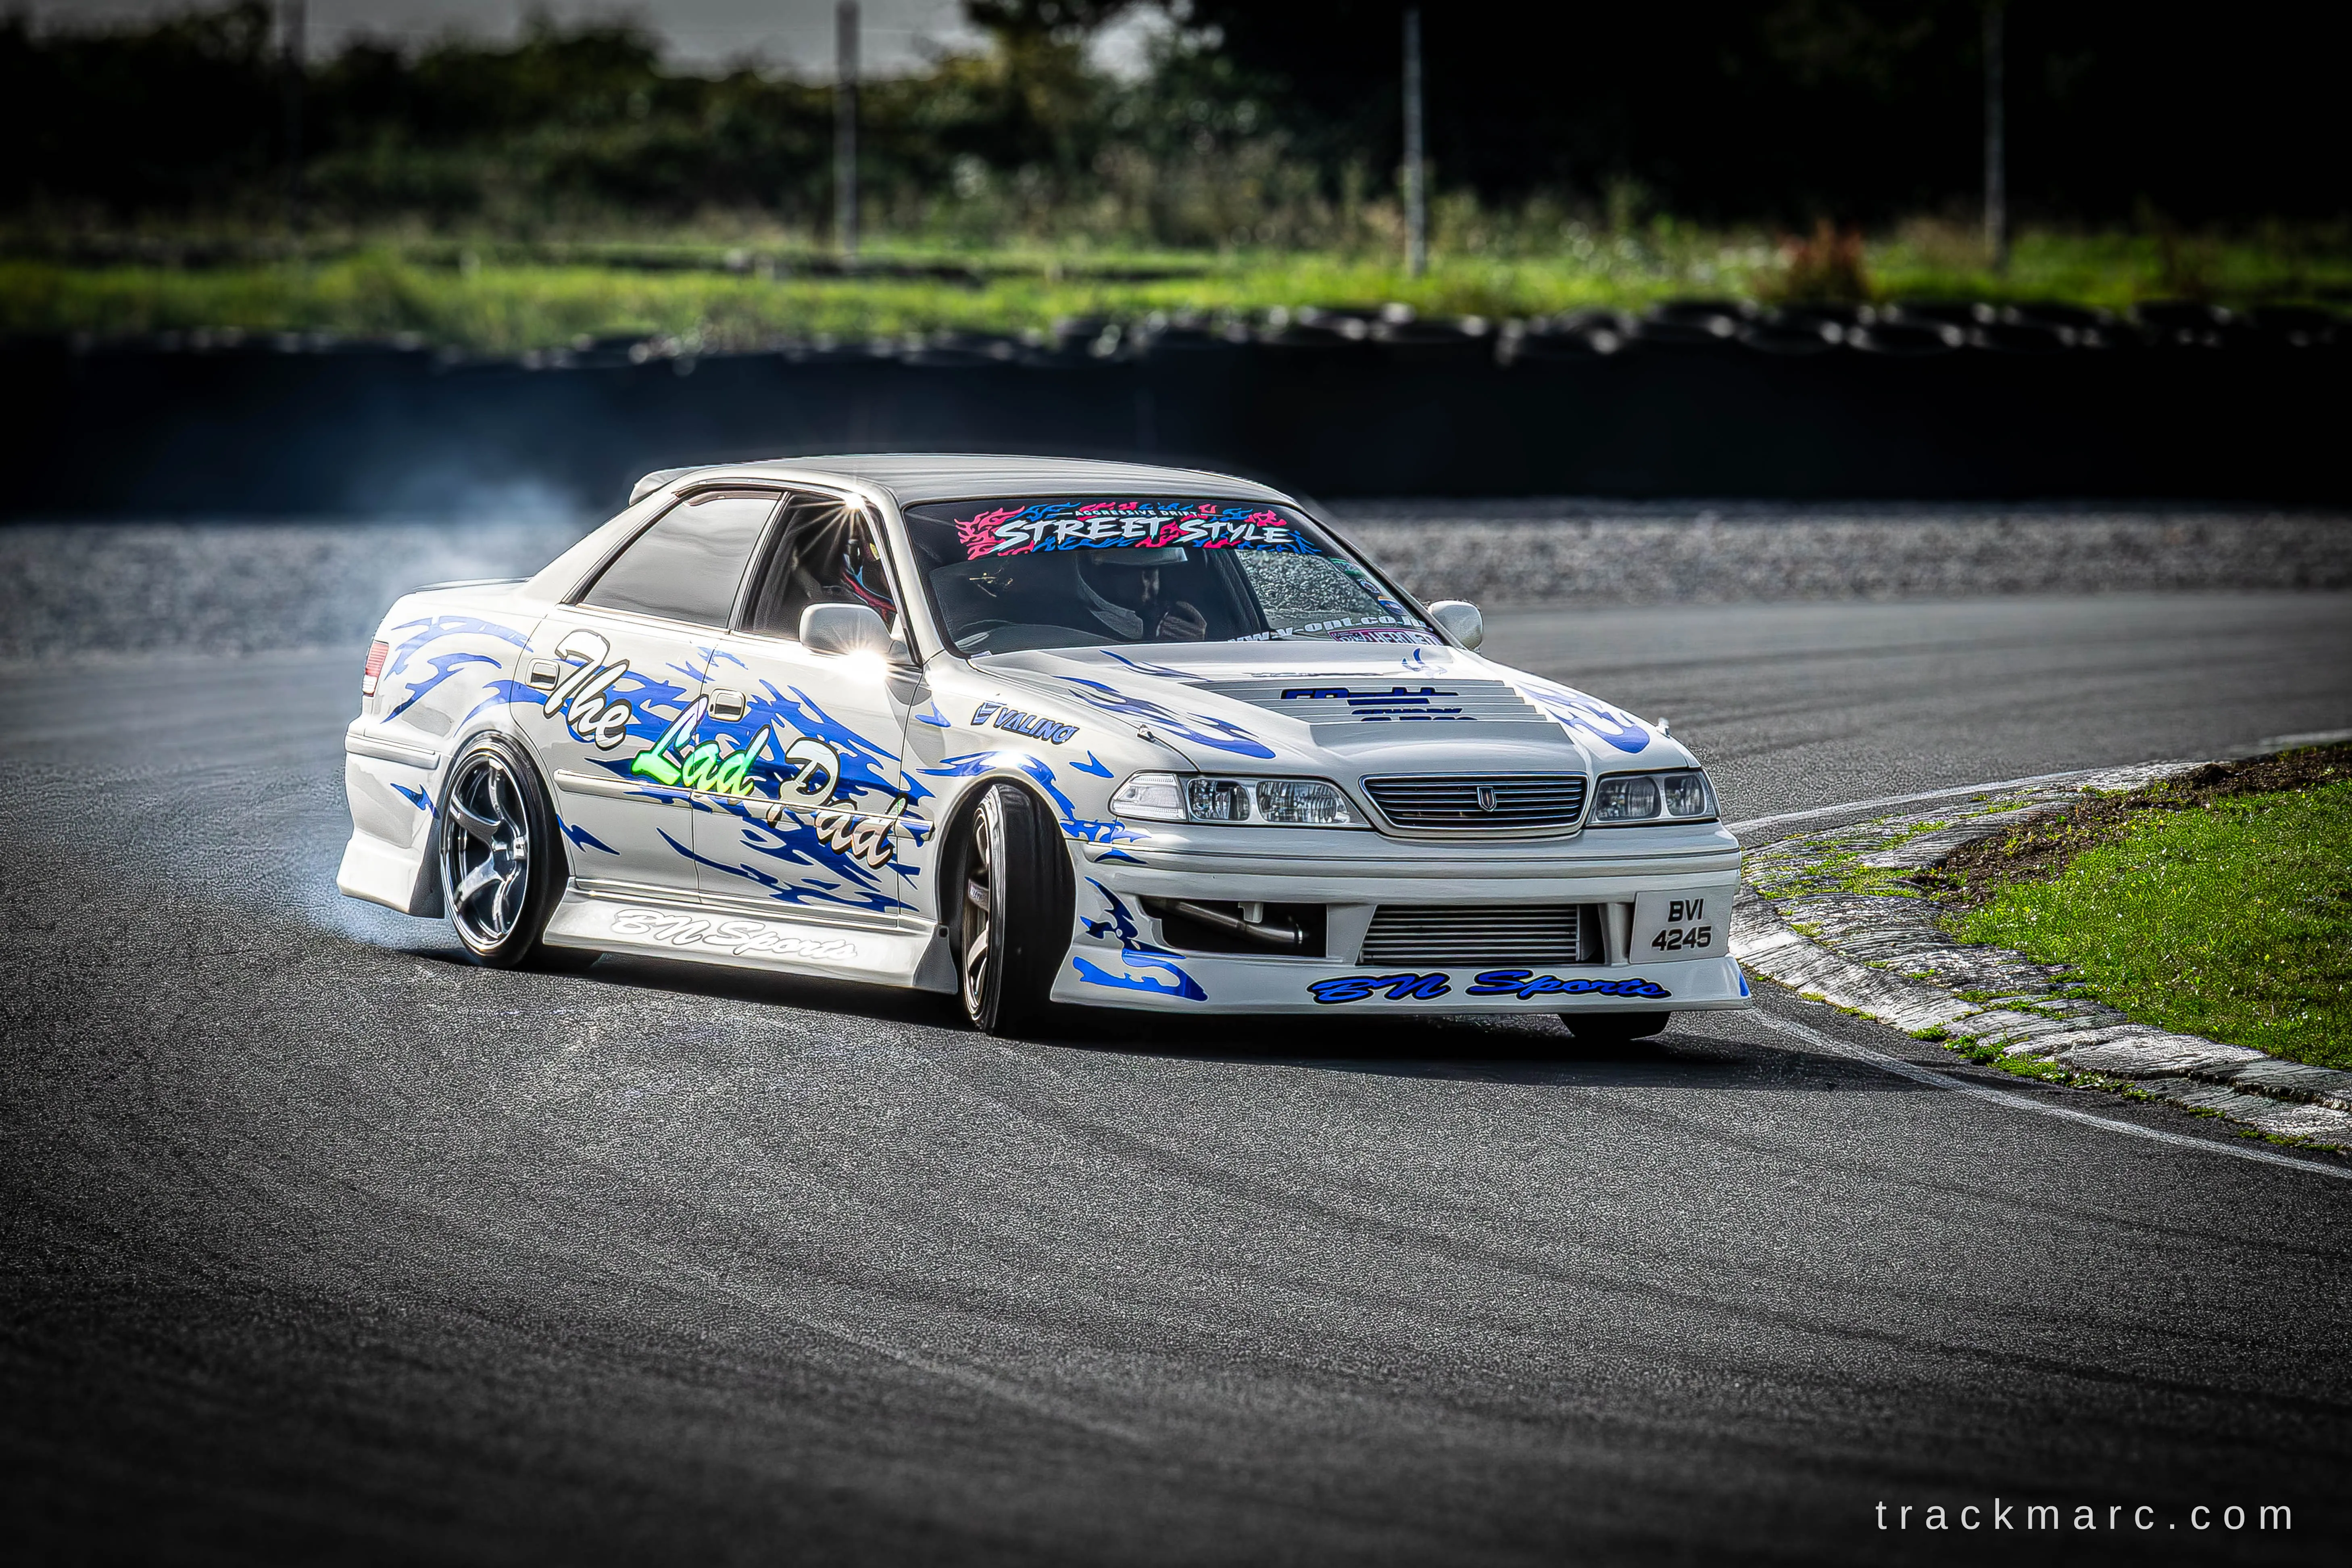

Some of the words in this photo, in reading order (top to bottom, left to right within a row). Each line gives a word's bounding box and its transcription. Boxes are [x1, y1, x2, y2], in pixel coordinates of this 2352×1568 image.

[987, 517, 1174, 553] STREET
[1173, 519, 1294, 547] STYLE
[544, 628, 632, 750] The
[630, 694, 771, 797] Lad
[993, 707, 1080, 745] VALINO
[1667, 898, 1704, 924] BVI
[702, 920, 858, 961] Sports
[1651, 925, 1712, 952] 4245
[1306, 972, 1452, 1004] BN
[1465, 968, 1673, 1003] Sports
